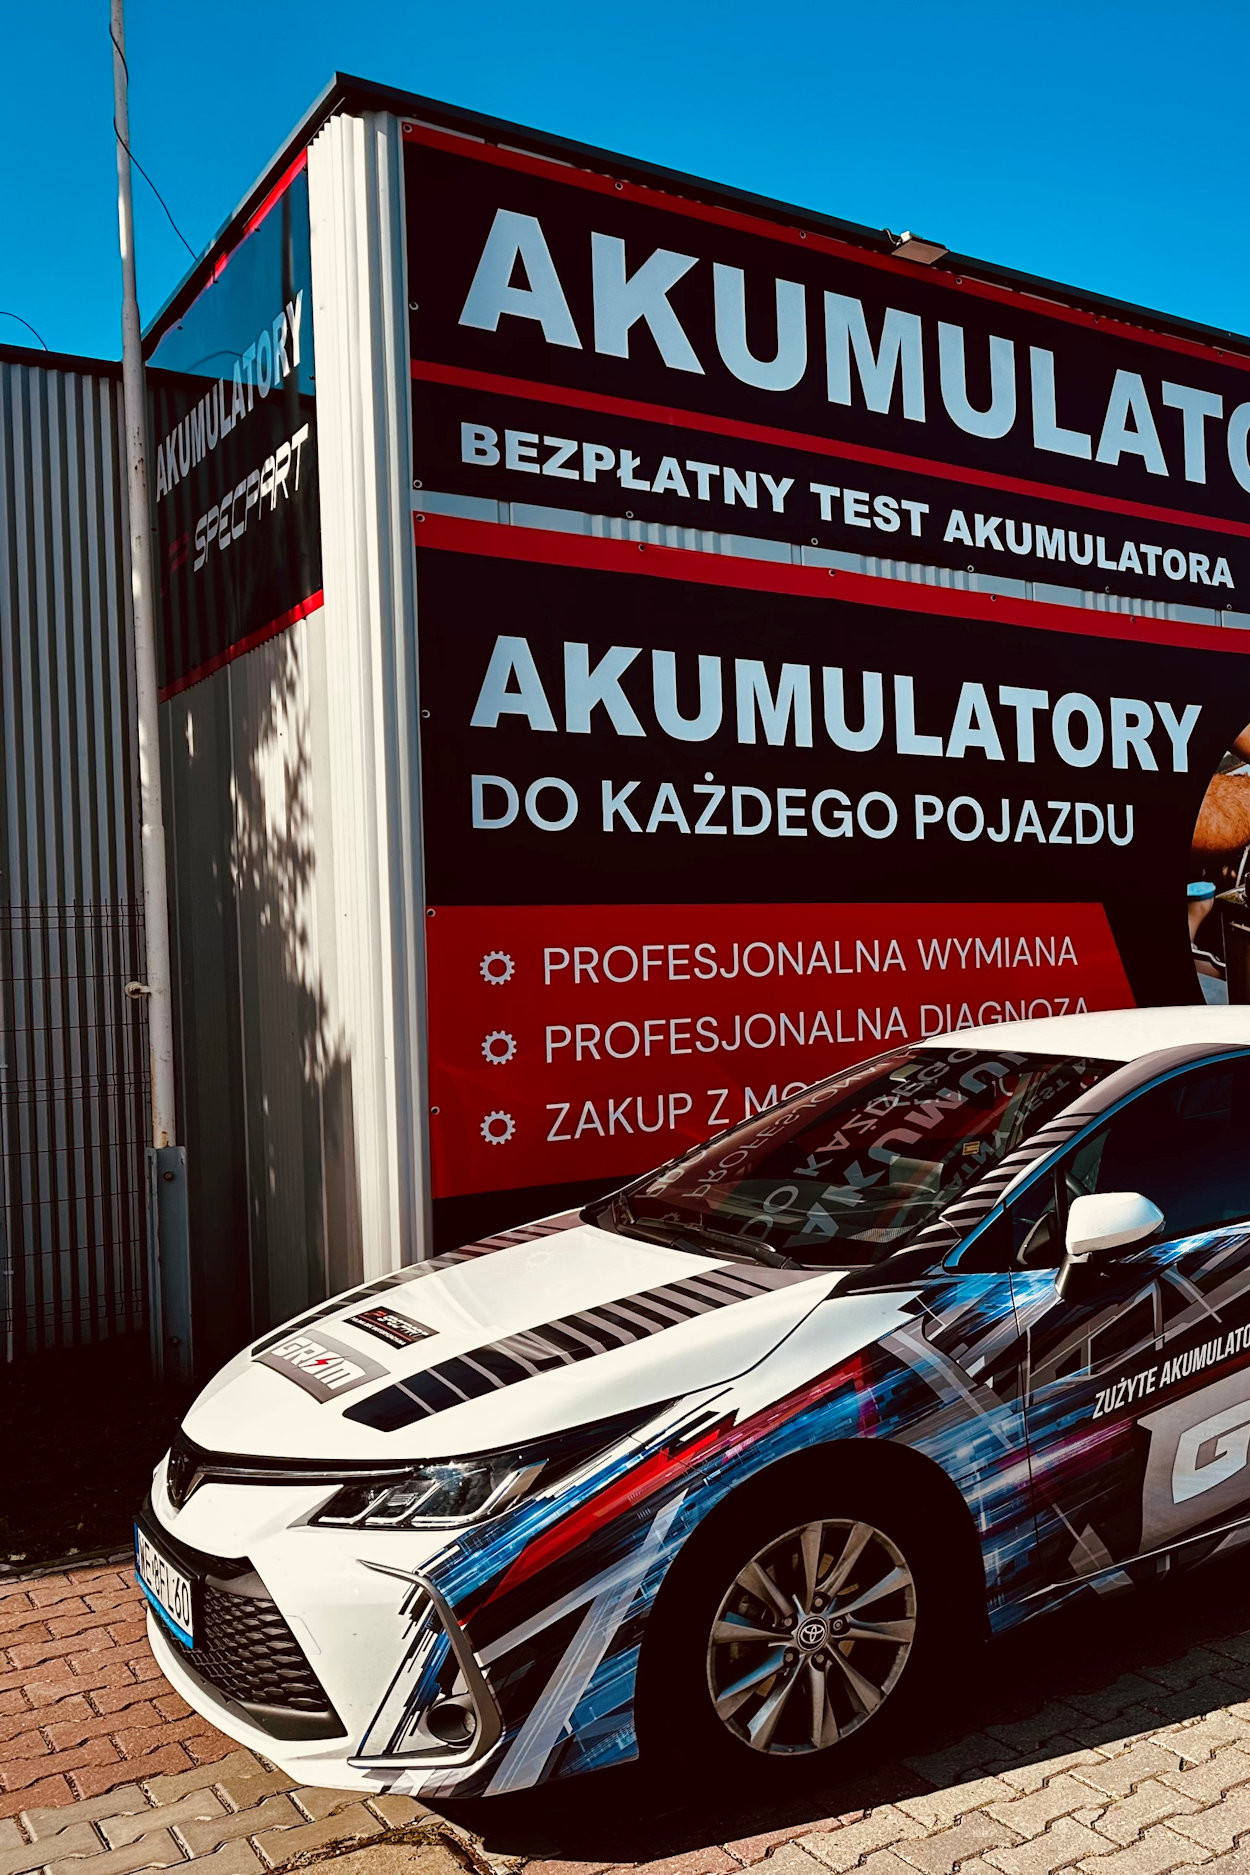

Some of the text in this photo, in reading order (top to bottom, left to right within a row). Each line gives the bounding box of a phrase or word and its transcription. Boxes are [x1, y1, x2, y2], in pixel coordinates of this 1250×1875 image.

[156, 289, 303, 503] AKUMULATORY
[194, 423, 309, 572] SPECPART
[461, 422, 1234, 588] BEZPŁATNY TEST AKUMULATORA
[470, 636, 1202, 772] AKUMULATORY
[472, 772, 1134, 845] DO KAŻDEGO POJAZDU
[544, 936, 1078, 985] PROFESJONALNA WYMIANA
[545, 1009, 908, 1063] PROFESJONALNA
[546, 1093, 693, 1142] ZAKUP
[707, 1089, 730, 1125] Z
[270, 1337, 367, 1390] GROM
[1092, 1366, 1158, 1420] ZUŻYTE
